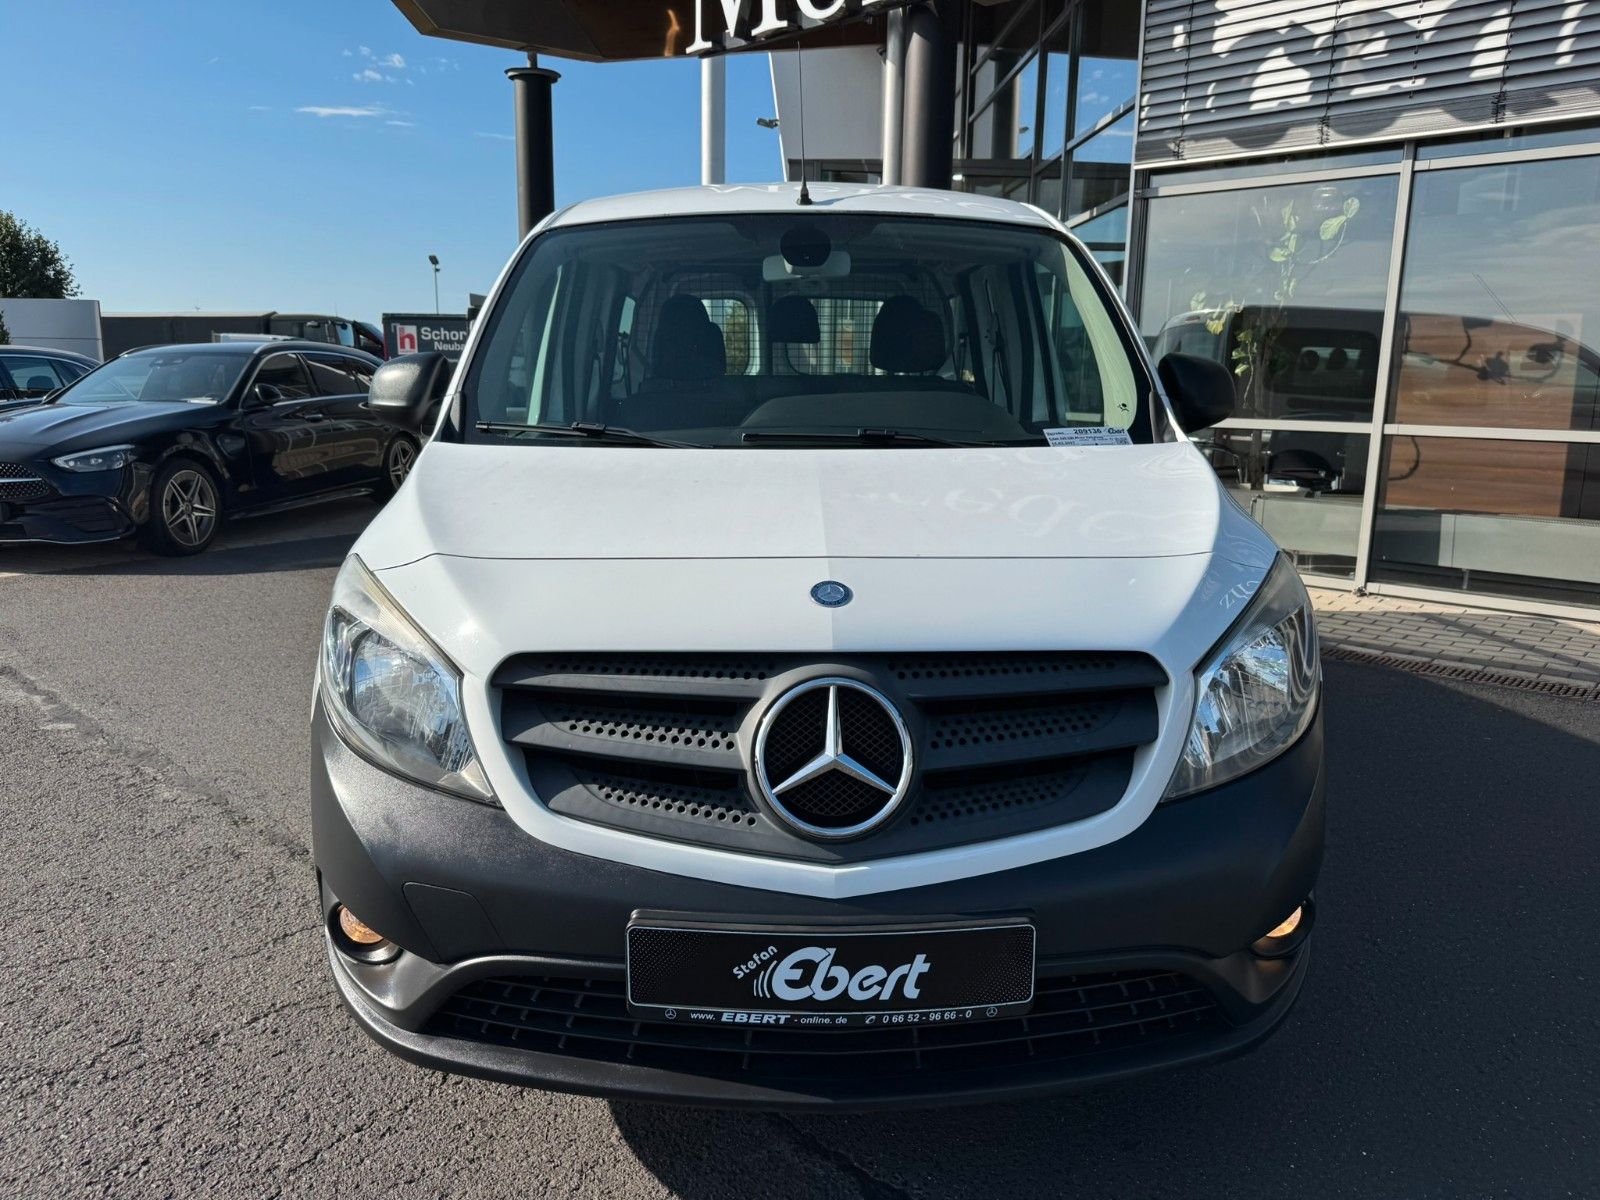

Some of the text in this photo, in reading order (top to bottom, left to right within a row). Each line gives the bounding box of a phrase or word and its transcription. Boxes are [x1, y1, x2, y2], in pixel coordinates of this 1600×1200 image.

[732, 945, 778, 980] Stefan
[772, 946, 931, 1001] Ebert
[690, 1012, 716, 1021] www.
[720, 1012, 791, 1024] EBERT
